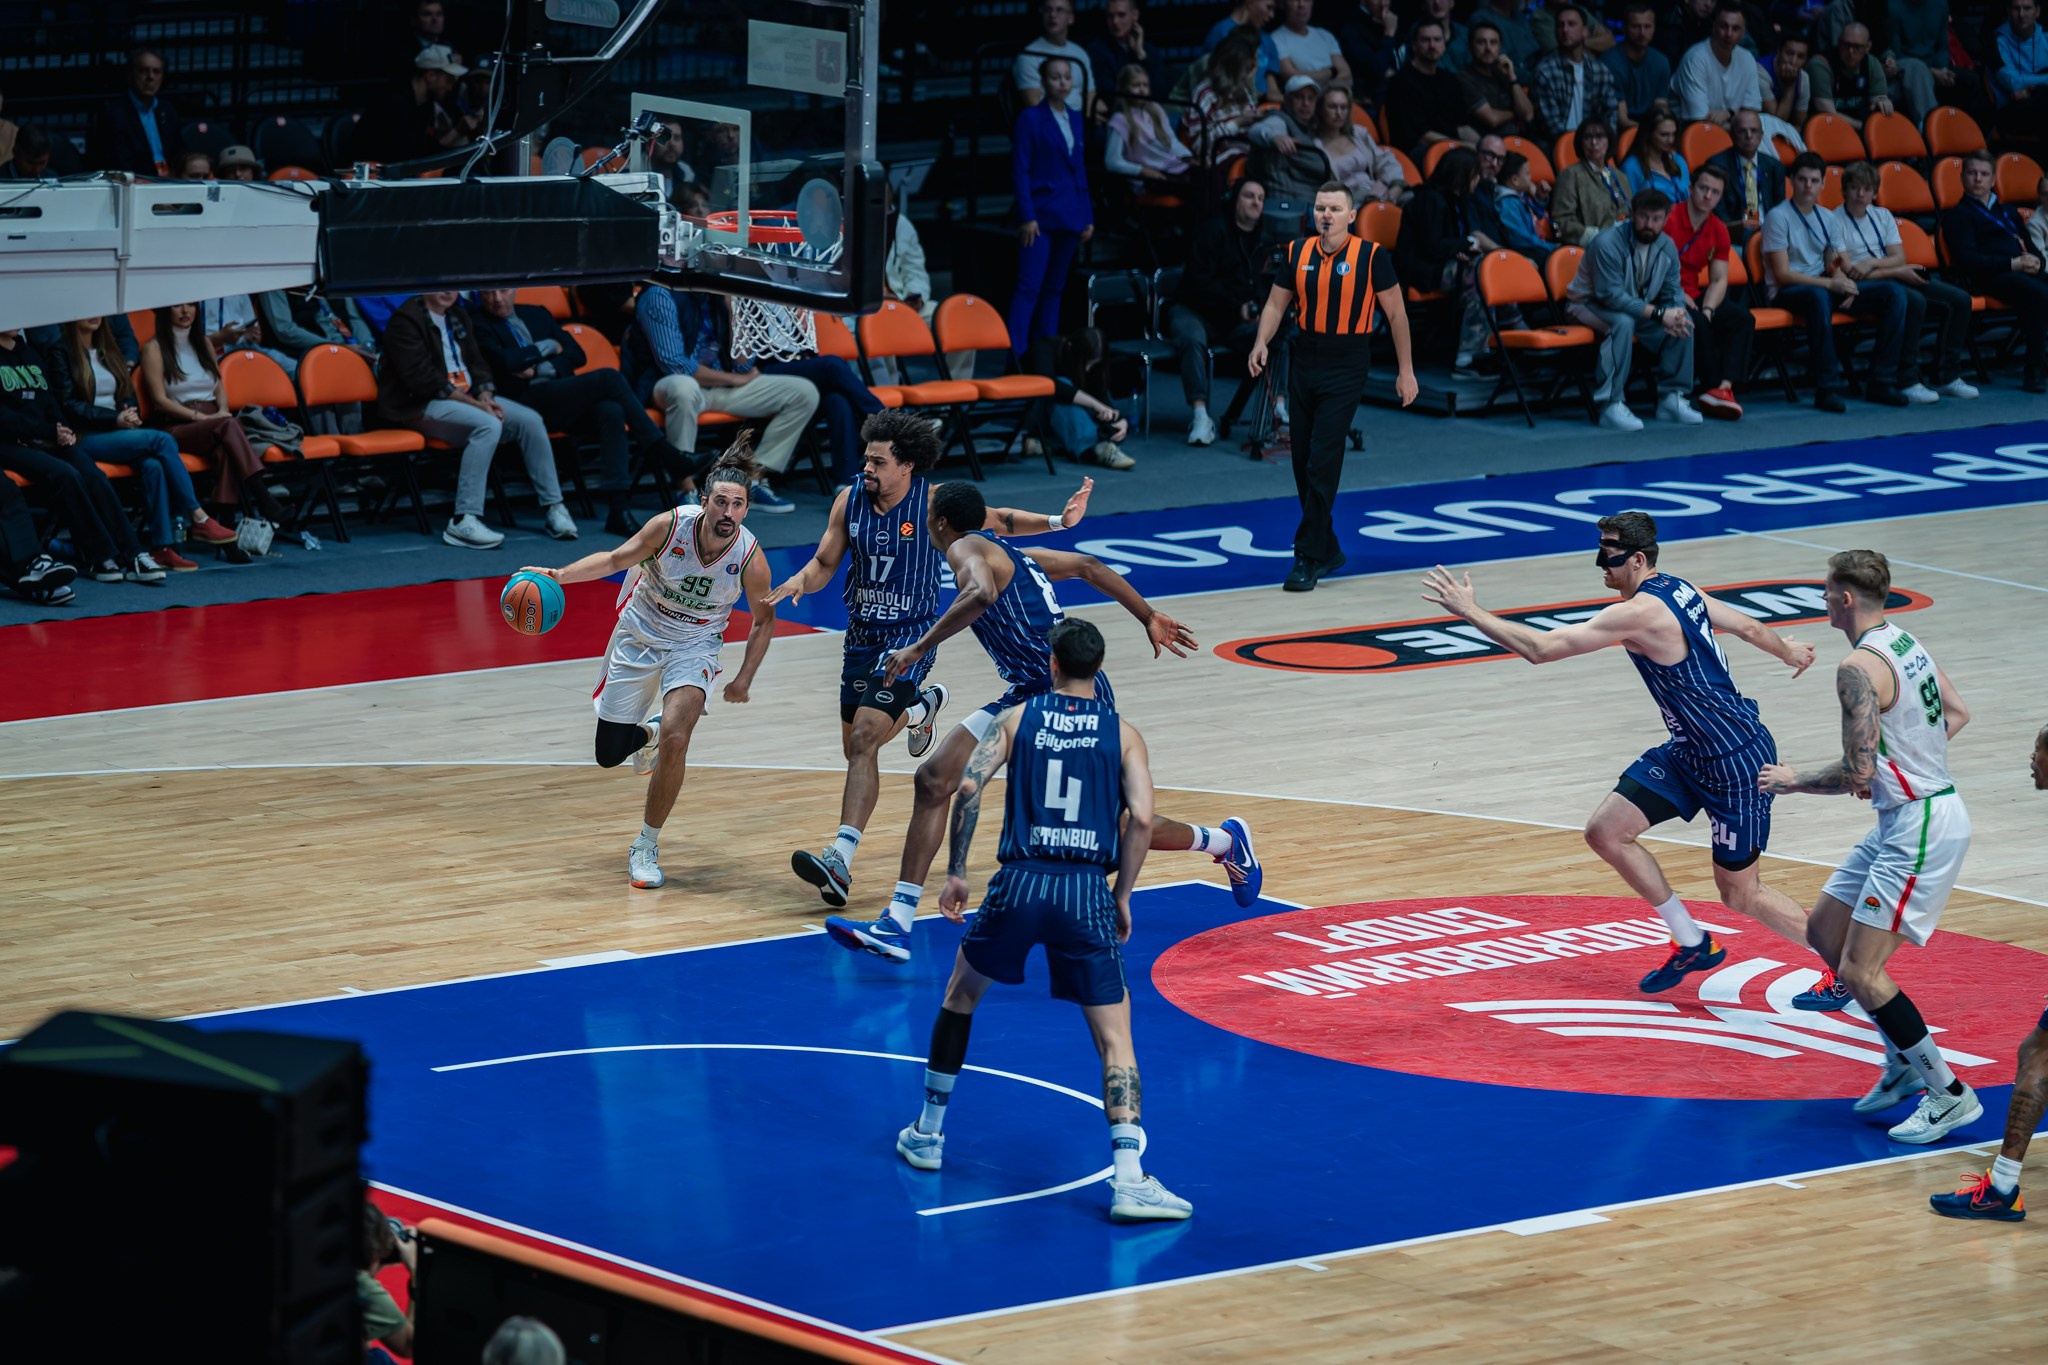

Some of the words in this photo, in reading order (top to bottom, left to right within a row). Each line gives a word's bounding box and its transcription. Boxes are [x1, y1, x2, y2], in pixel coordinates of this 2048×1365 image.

[869, 555, 896, 583] 17
[680, 574, 715, 598] 95
[857, 588, 911, 611] ANADOLU
[659, 605, 698, 623] WINLINE
[1042, 710, 1099, 733] YUSTA
[1044, 759, 1082, 822] 4
[1711, 816, 1737, 850] 24
[1273, 907, 1530, 953] СПОРТ
